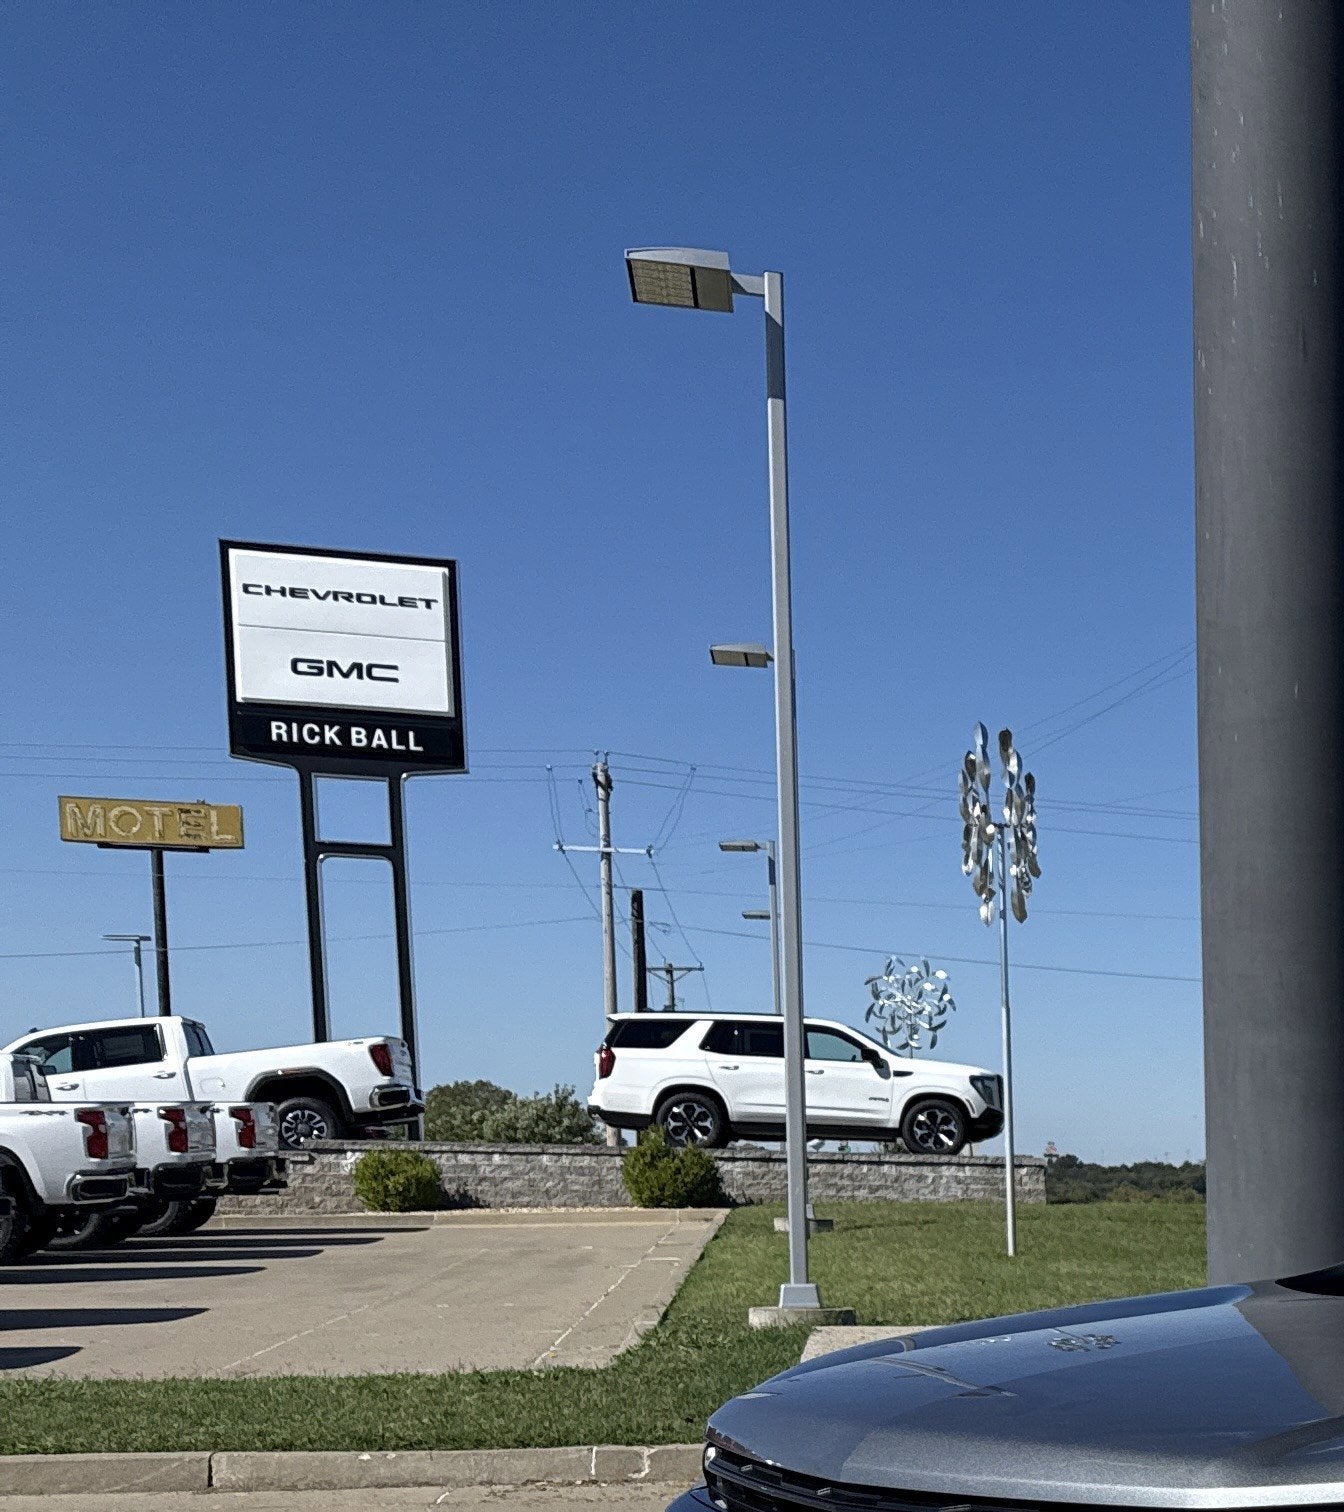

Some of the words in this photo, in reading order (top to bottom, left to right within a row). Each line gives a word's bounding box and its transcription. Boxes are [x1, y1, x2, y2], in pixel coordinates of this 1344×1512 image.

[242, 582, 439, 610] CHEVROLET
[290, 657, 399, 683] GMC
[270, 720, 342, 747] RICK
[350, 726, 424, 752] BALL
[66, 803, 240, 845] MOTEL
